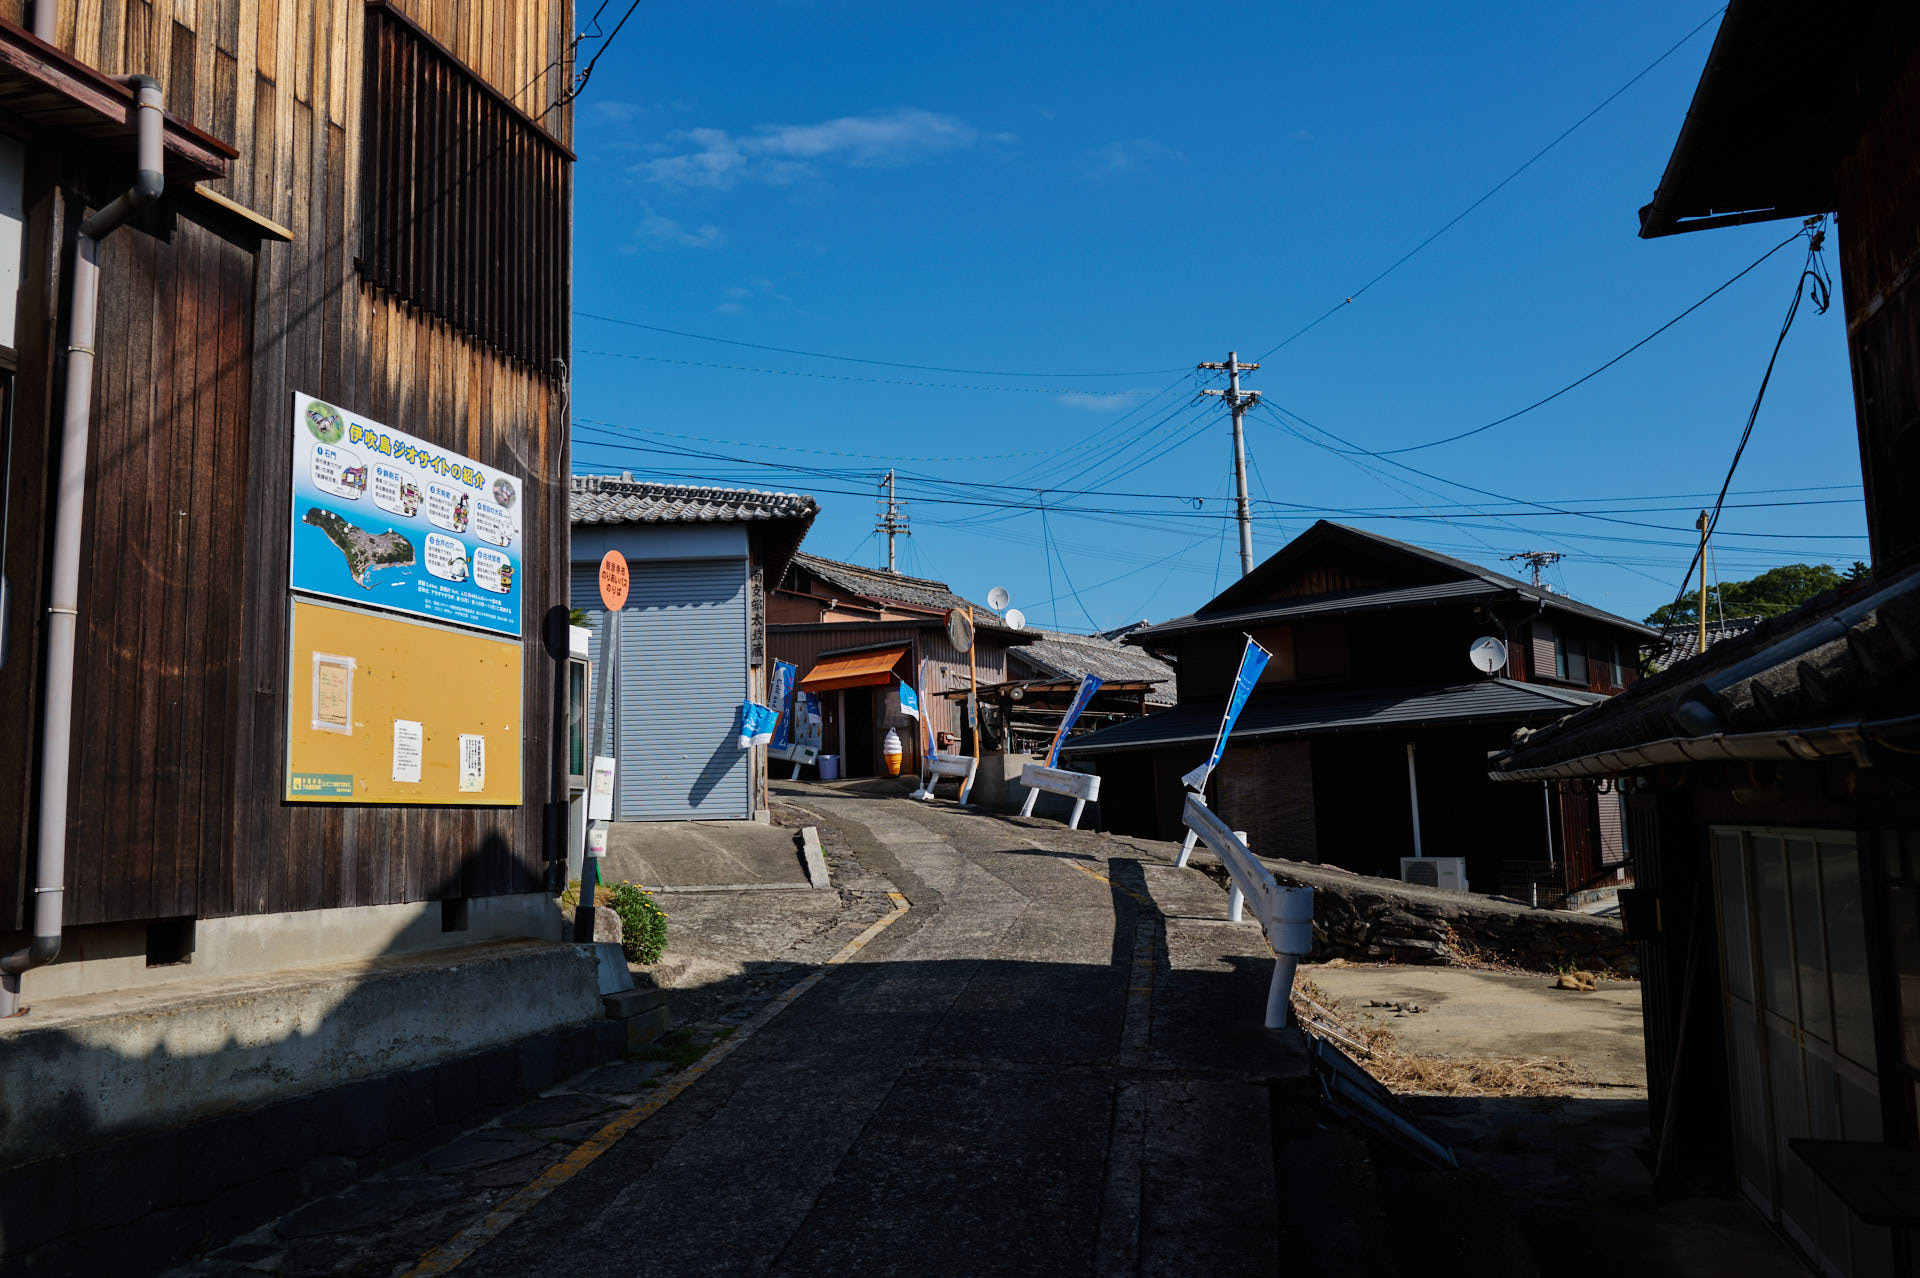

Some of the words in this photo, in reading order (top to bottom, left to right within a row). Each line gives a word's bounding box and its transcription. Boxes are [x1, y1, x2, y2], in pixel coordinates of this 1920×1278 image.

[349, 423, 486, 491] 伊吹島ジオサイトの紹介
[602, 571, 628, 588] のりあいバス
[606, 583, 622, 596] のりば
